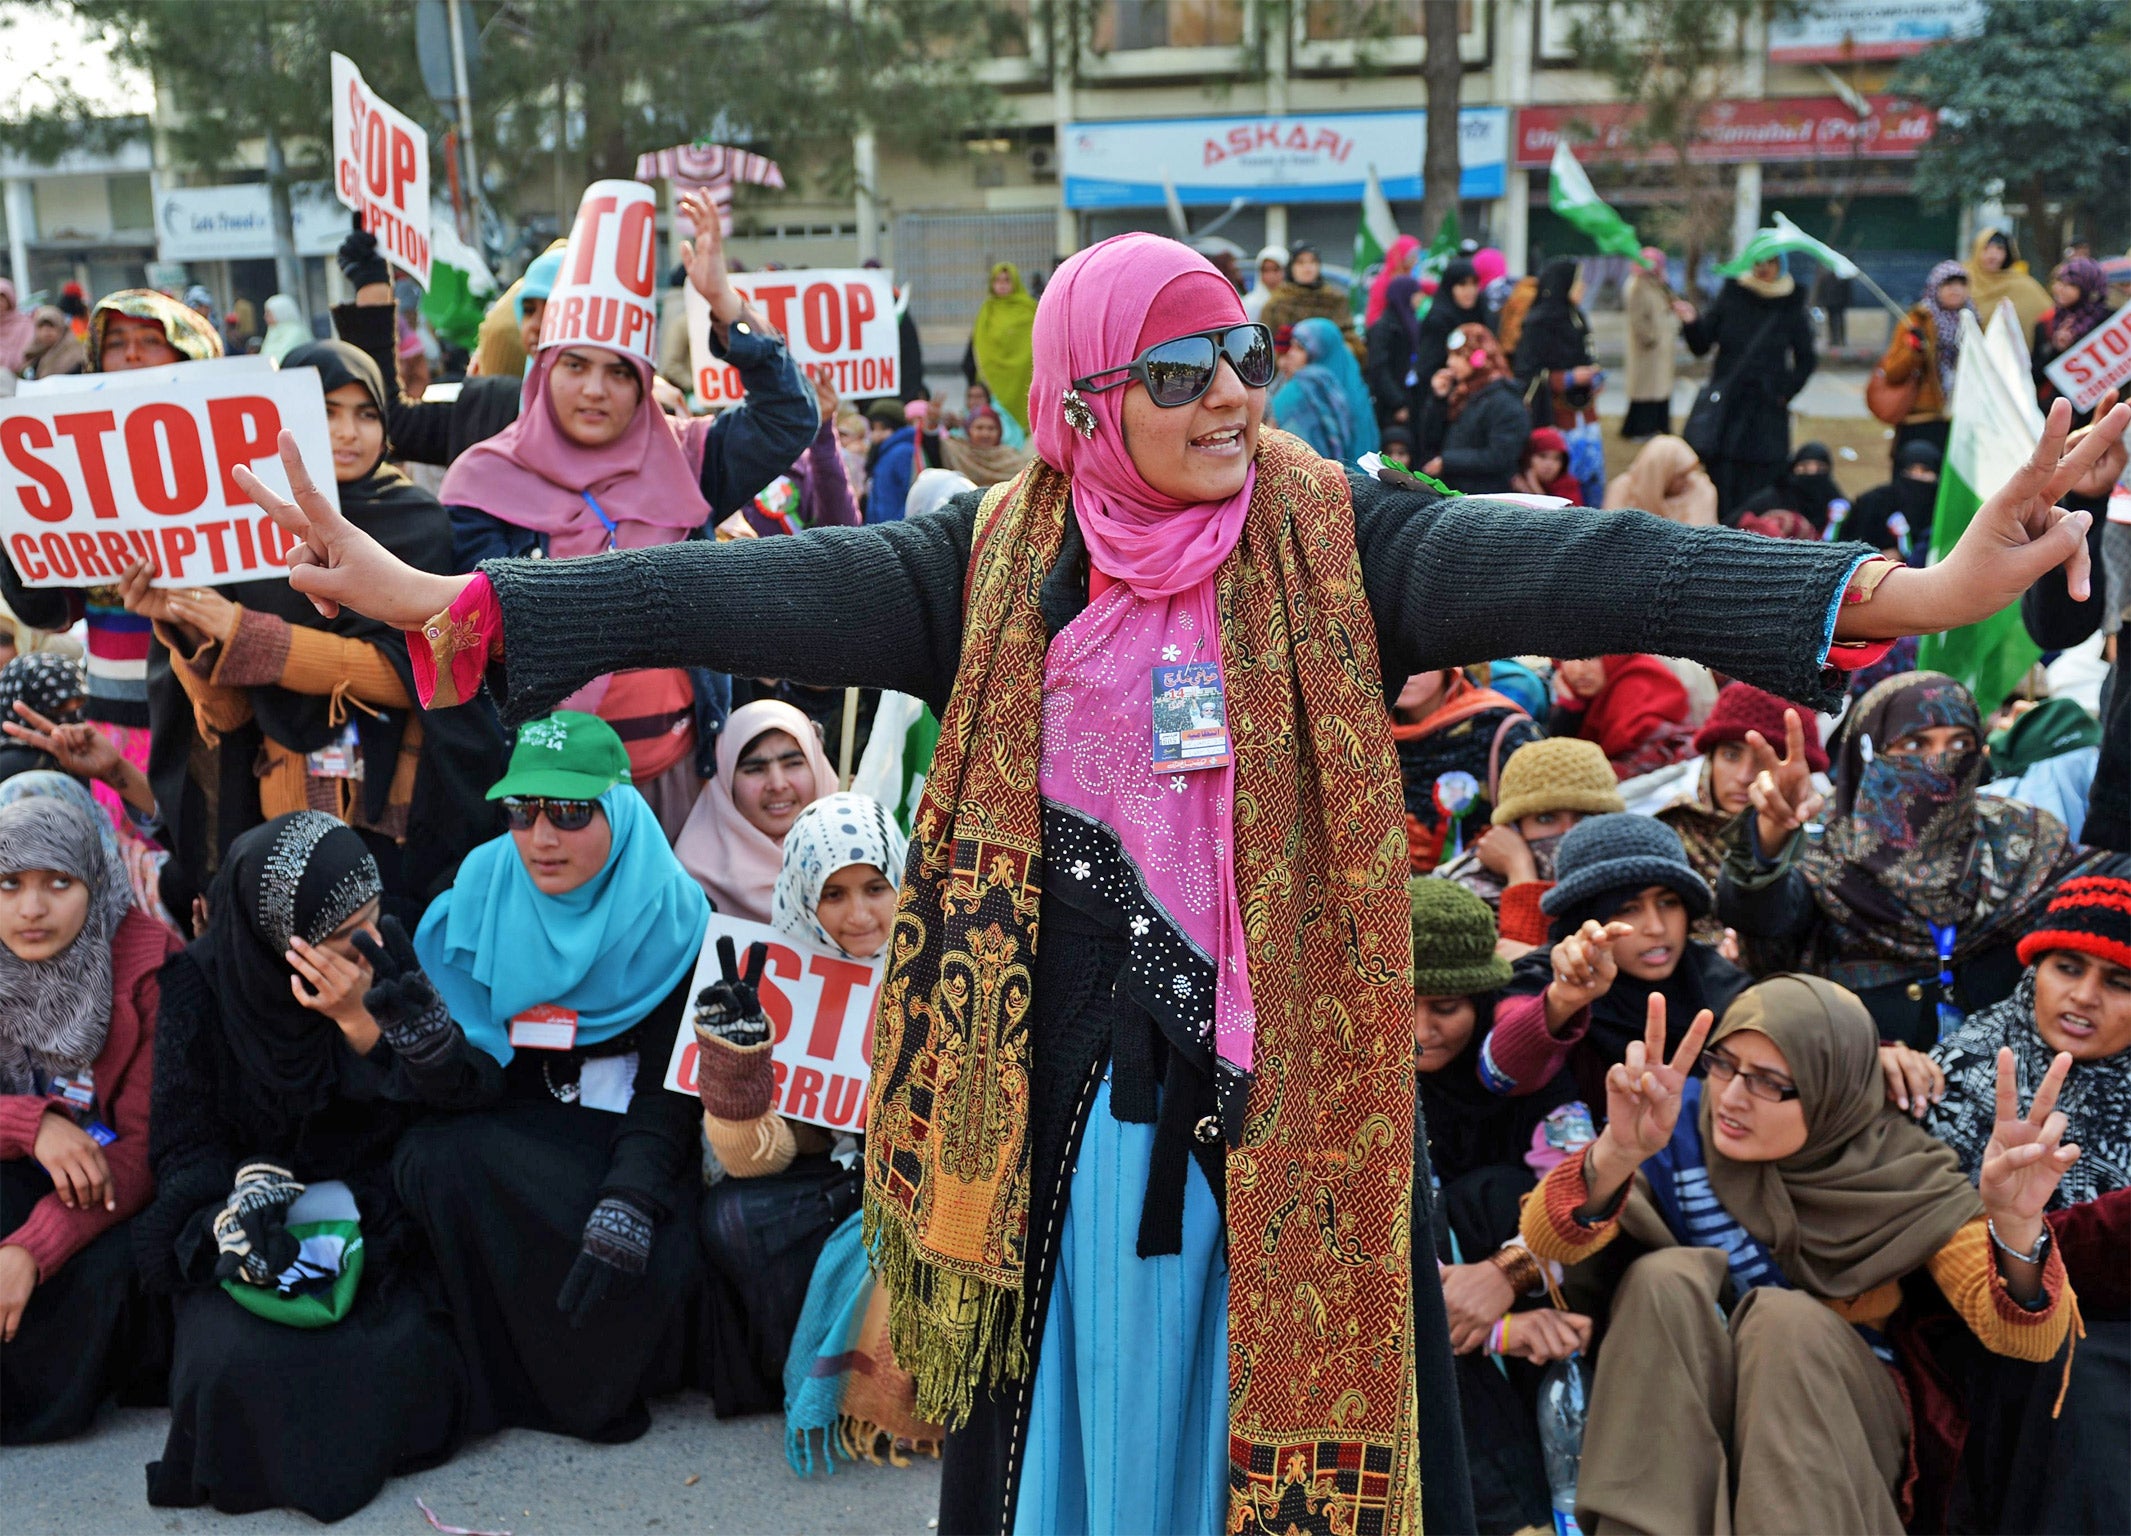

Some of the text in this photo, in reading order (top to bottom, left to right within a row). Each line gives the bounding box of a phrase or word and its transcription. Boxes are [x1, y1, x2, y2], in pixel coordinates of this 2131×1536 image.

[350, 78, 416, 212] STOP
[1203, 121, 1354, 167] ASKARI
[735, 282, 876, 354] TOP
[0, 395, 282, 522] STOP
[11, 515, 304, 580] CORRUPTIO
[739, 942, 883, 1062] ST
